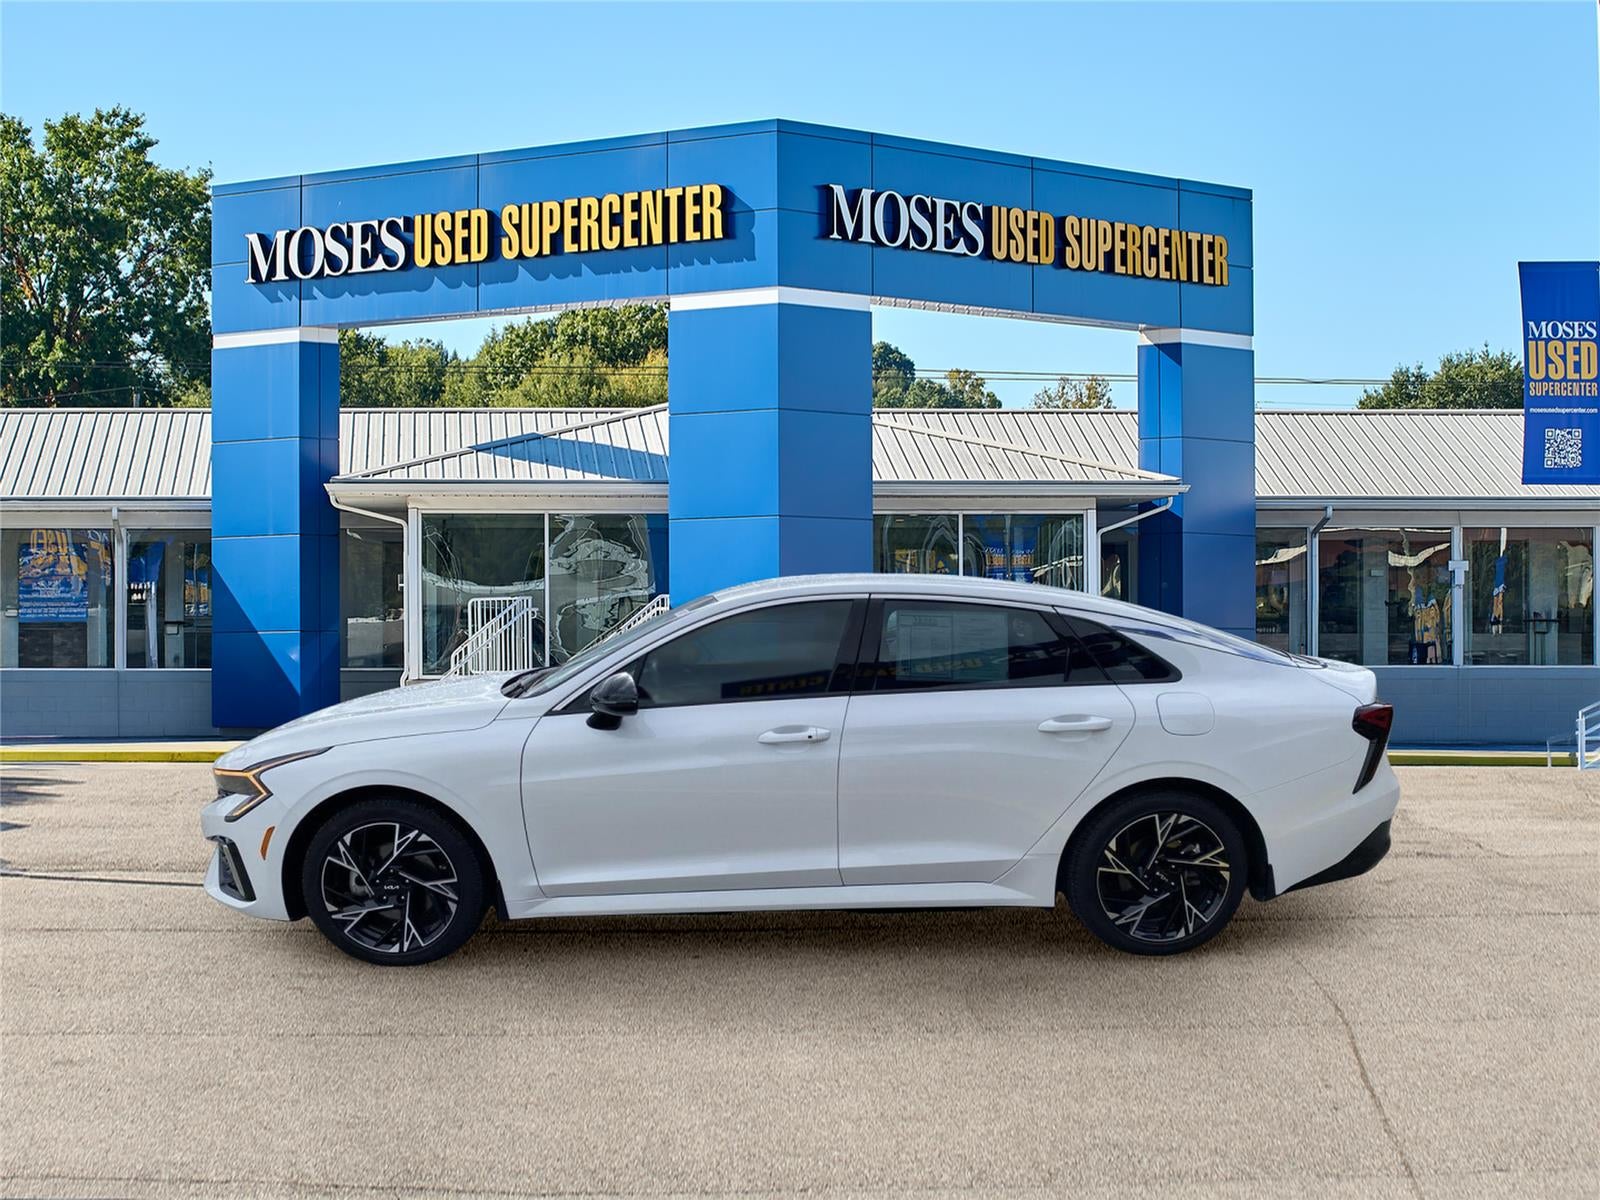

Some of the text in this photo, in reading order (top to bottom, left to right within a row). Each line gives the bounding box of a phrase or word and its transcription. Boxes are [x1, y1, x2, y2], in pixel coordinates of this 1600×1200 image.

[244, 183, 725, 284] MOSES USED SUPERCENTER
[828, 183, 1230, 287] MOSES USED SUPERCENTER
[1527, 320, 1597, 339] MOSES
[1528, 340, 1598, 380] USED
[1529, 381, 1599, 397] SUPERCENTER
